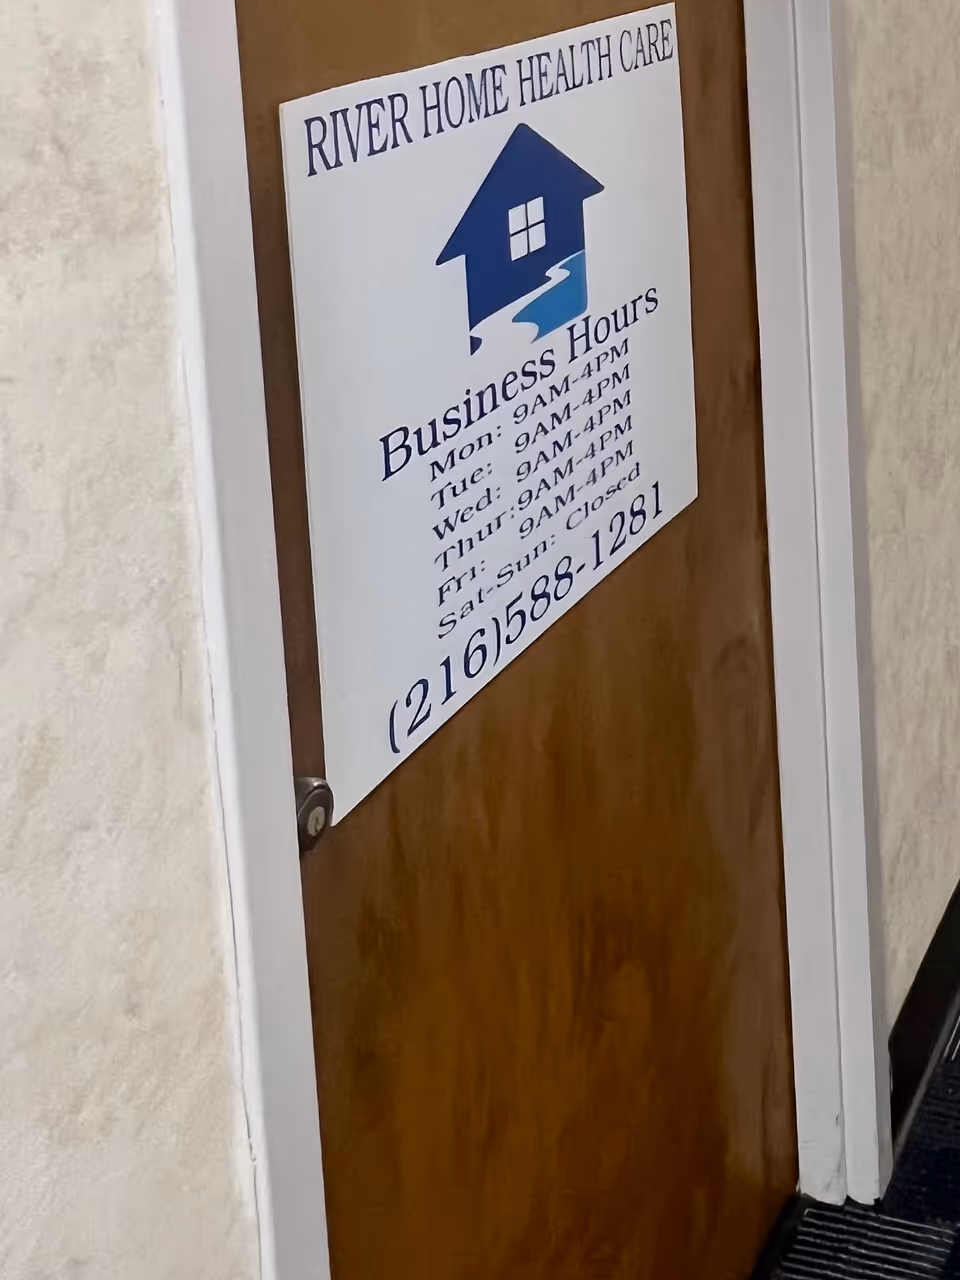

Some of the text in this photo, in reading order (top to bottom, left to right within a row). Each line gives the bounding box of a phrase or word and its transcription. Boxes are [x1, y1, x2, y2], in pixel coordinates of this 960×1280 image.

[304, 19, 674, 177] RIVER HOME HEALTH CARE
[379, 287, 659, 482] Business Hours
[430, 337, 629, 482] Mon: 9AM-4PM
[430, 363, 631, 510] Tue: 9AM-4PM
[431, 389, 632, 541] Wed: 9AM-4PM
[438, 440, 634, 607] Fri: 9AM-4PM
[438, 462, 641, 639] Sat-Sun: Closed
[389, 480, 663, 754] (216)588-1281
